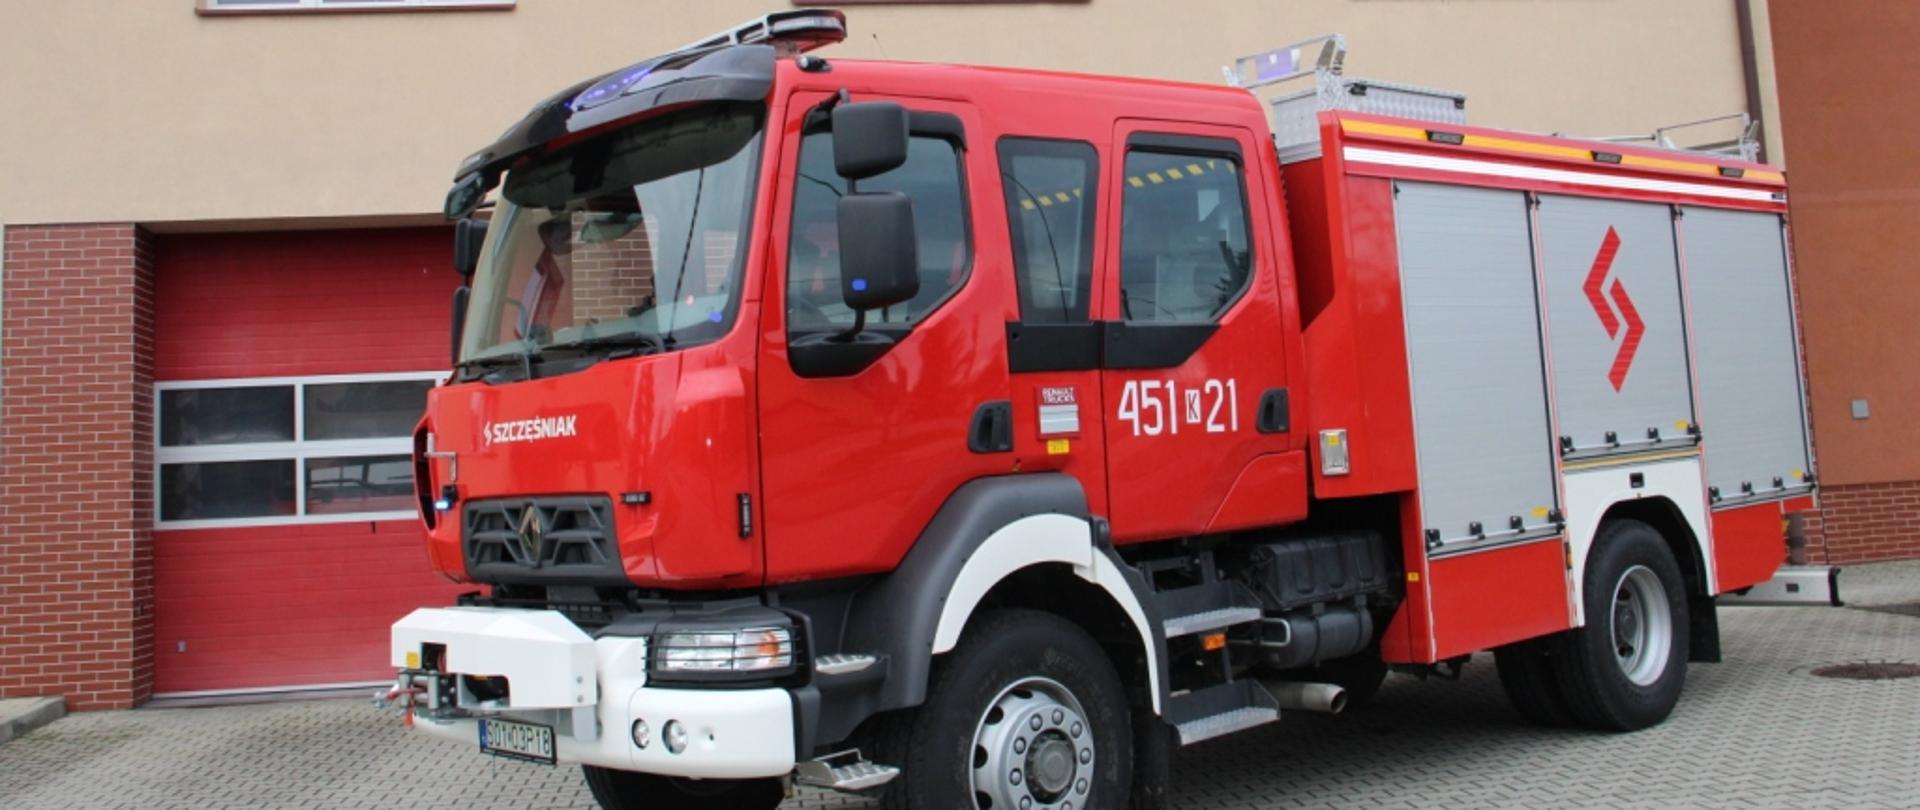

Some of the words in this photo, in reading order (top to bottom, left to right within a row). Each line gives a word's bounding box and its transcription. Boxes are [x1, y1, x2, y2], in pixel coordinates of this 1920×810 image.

[1118, 379, 1178, 436] 451
[1205, 378, 1238, 432] 21
[493, 415, 576, 444] SZCZĘŚNIAK
